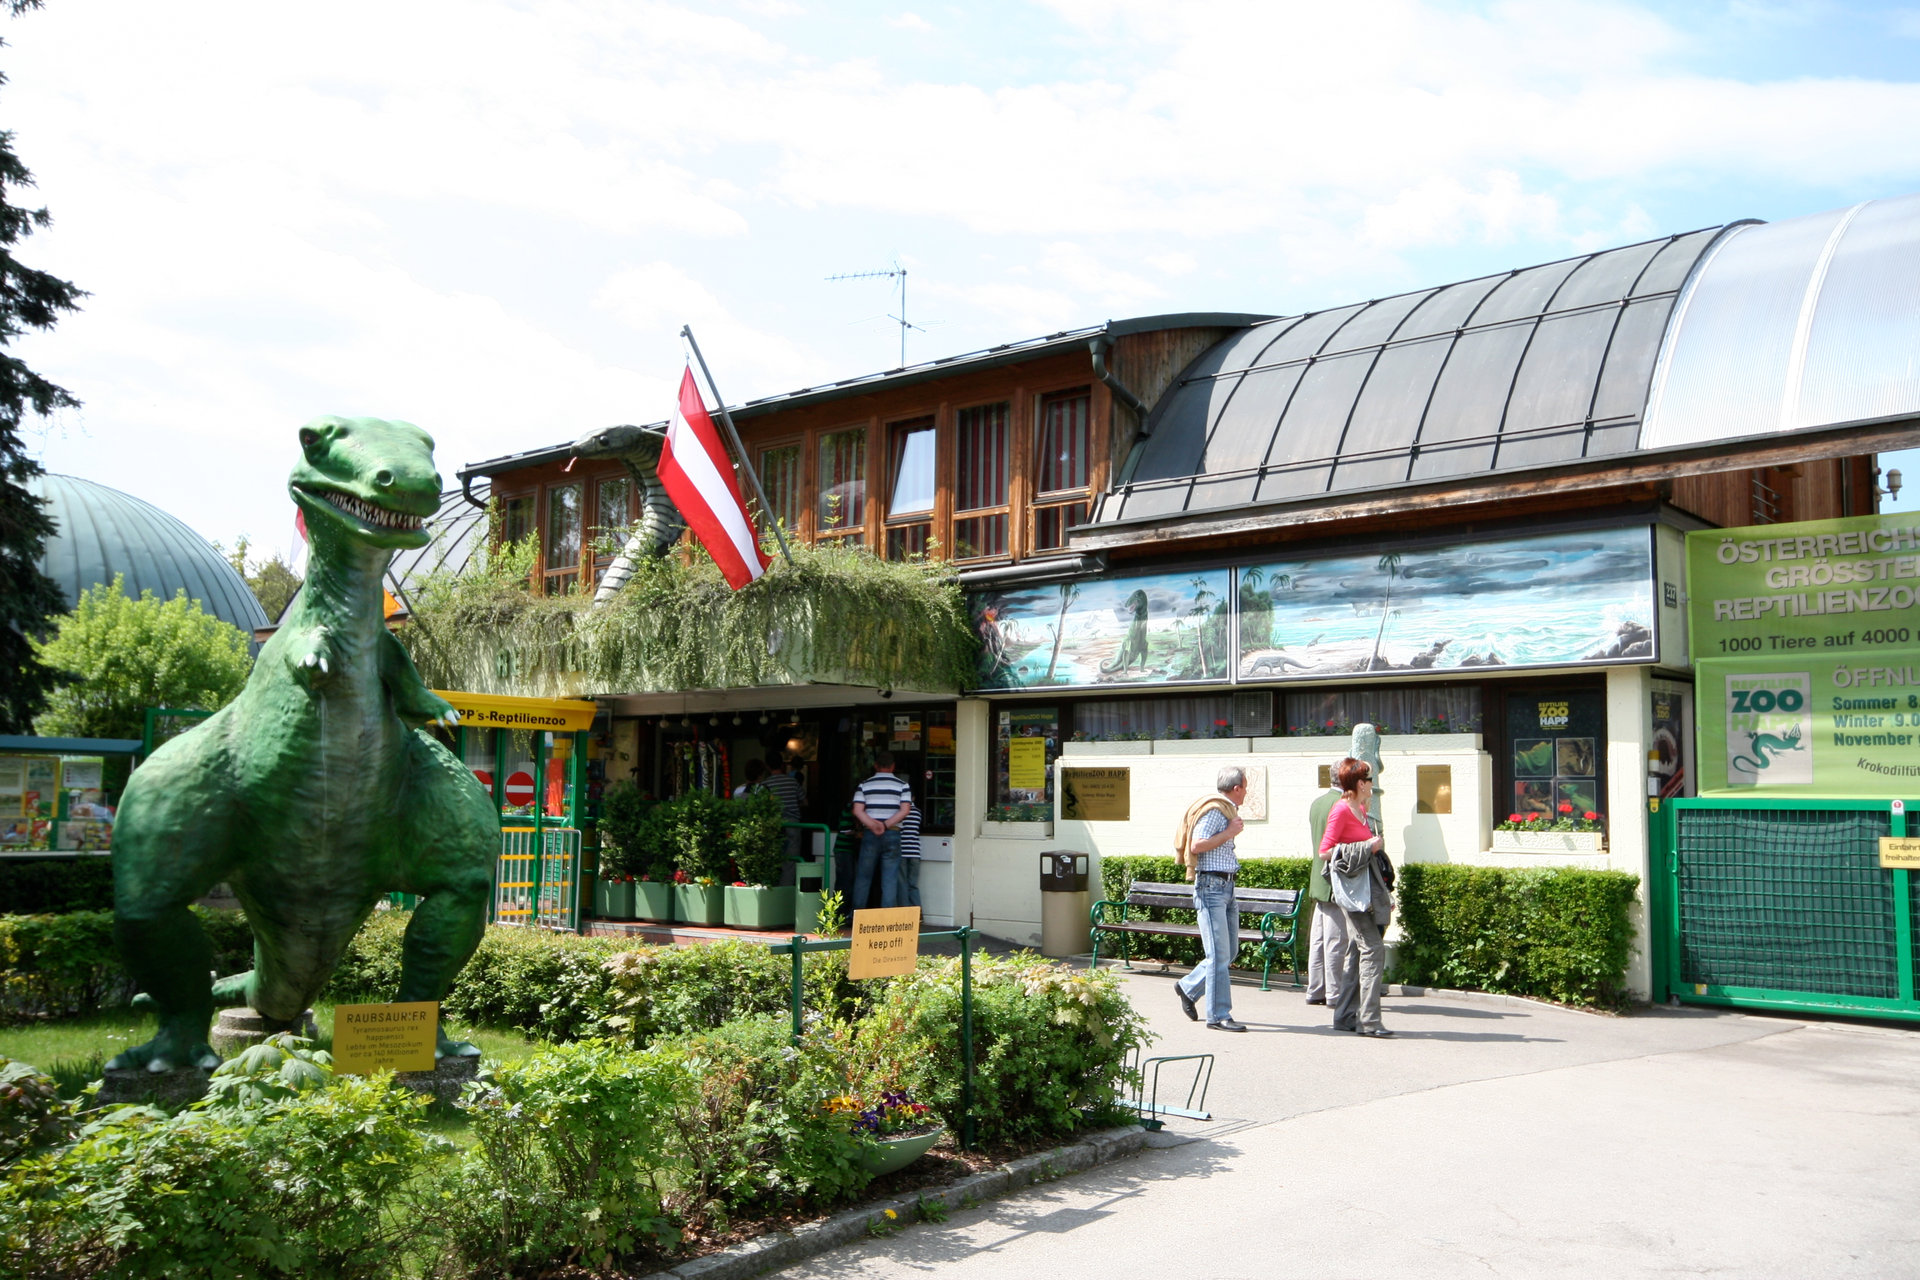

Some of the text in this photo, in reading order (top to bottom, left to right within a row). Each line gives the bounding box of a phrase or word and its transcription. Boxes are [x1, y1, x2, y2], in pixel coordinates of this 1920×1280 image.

[1717, 527, 1920, 565] ÖSTERREICH
[1765, 555, 1920, 589] GRÖSSTE
[1719, 637, 1762, 652] 1000
[1768, 635, 1817, 650] Tiere
[1824, 631, 1856, 647] auf
[1861, 627, 1910, 644] 4000
[1731, 689, 1804, 713] ZOO
[1832, 696, 1898, 711] Sommer
[1539, 706, 1569, 718] ZOO
[1540, 716, 1569, 725] HAPP
[1833, 714, 1885, 729] Winter
[1834, 732, 1913, 746] November
[859, 923, 885, 934] Betreten
[869, 939, 888, 950] keep
